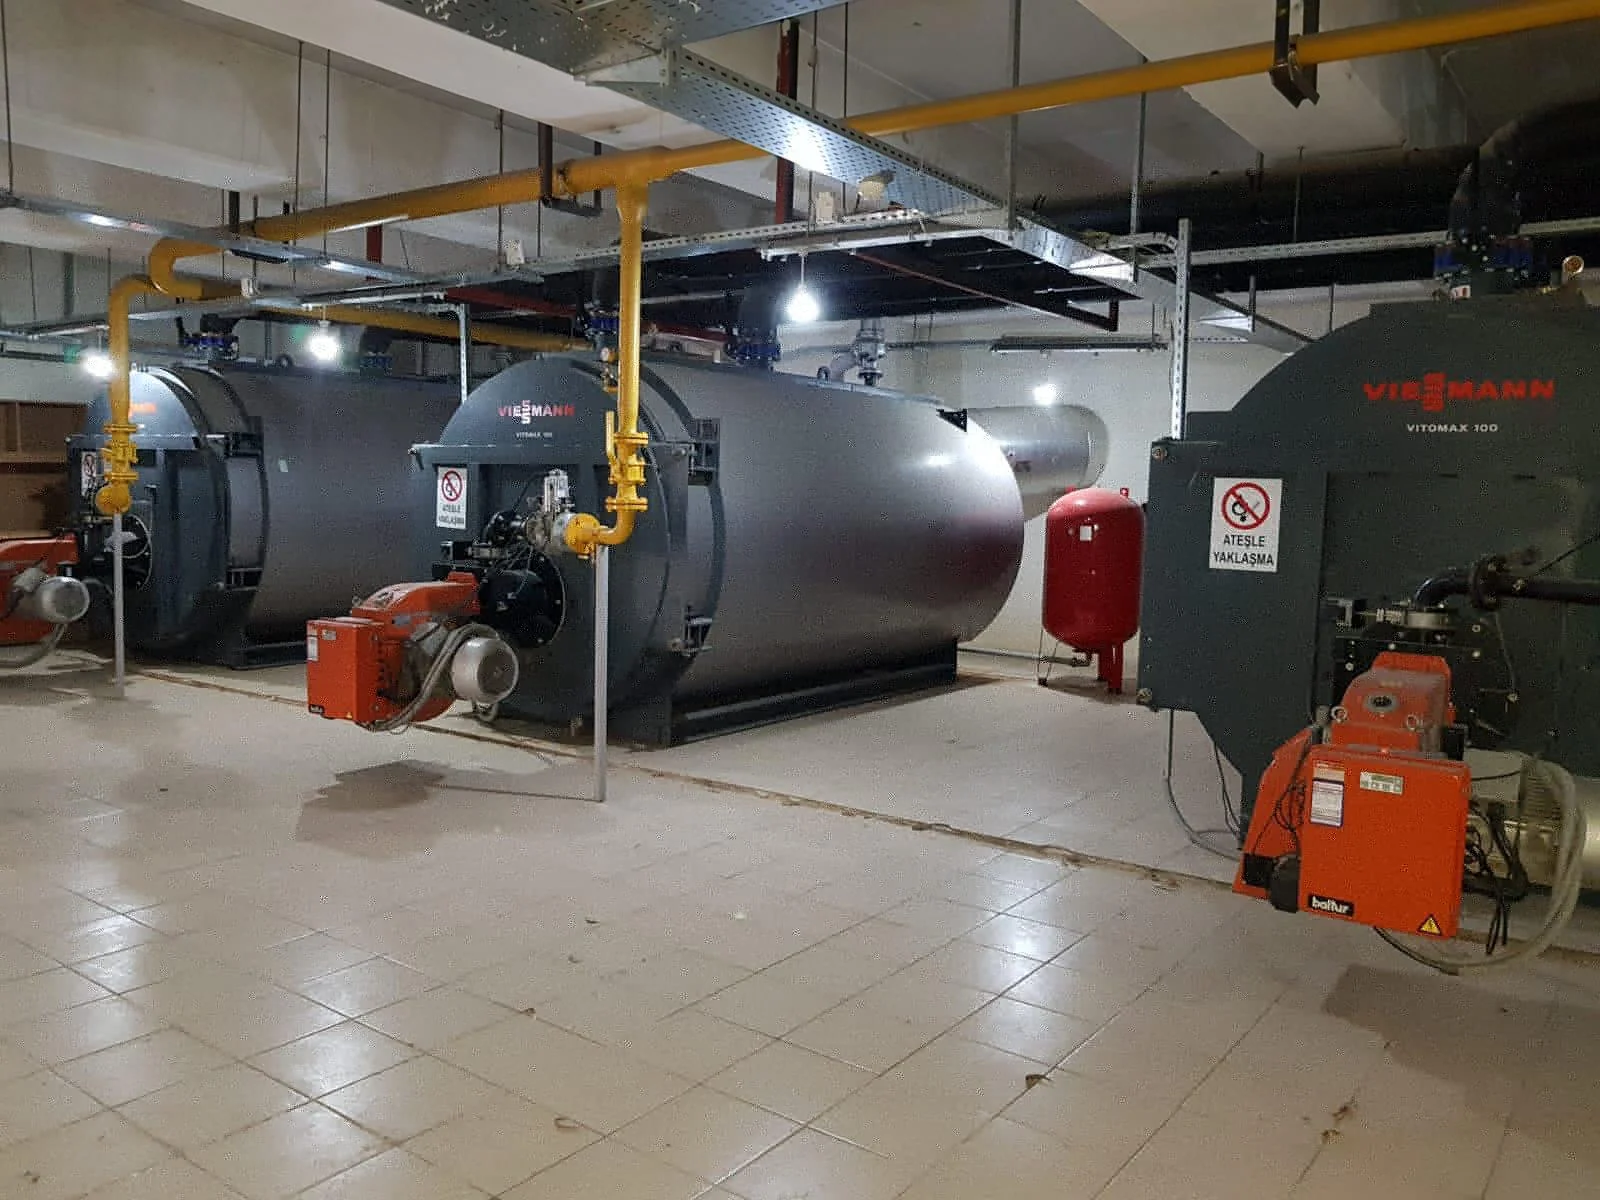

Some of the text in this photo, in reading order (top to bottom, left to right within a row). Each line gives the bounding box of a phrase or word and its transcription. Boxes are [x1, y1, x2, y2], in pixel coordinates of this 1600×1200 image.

[1407, 423, 1499, 433] VITOMAX 100
[1223, 534, 1265, 549] ATEŞLE
[1213, 551, 1275, 567] YAKLAŞMA
